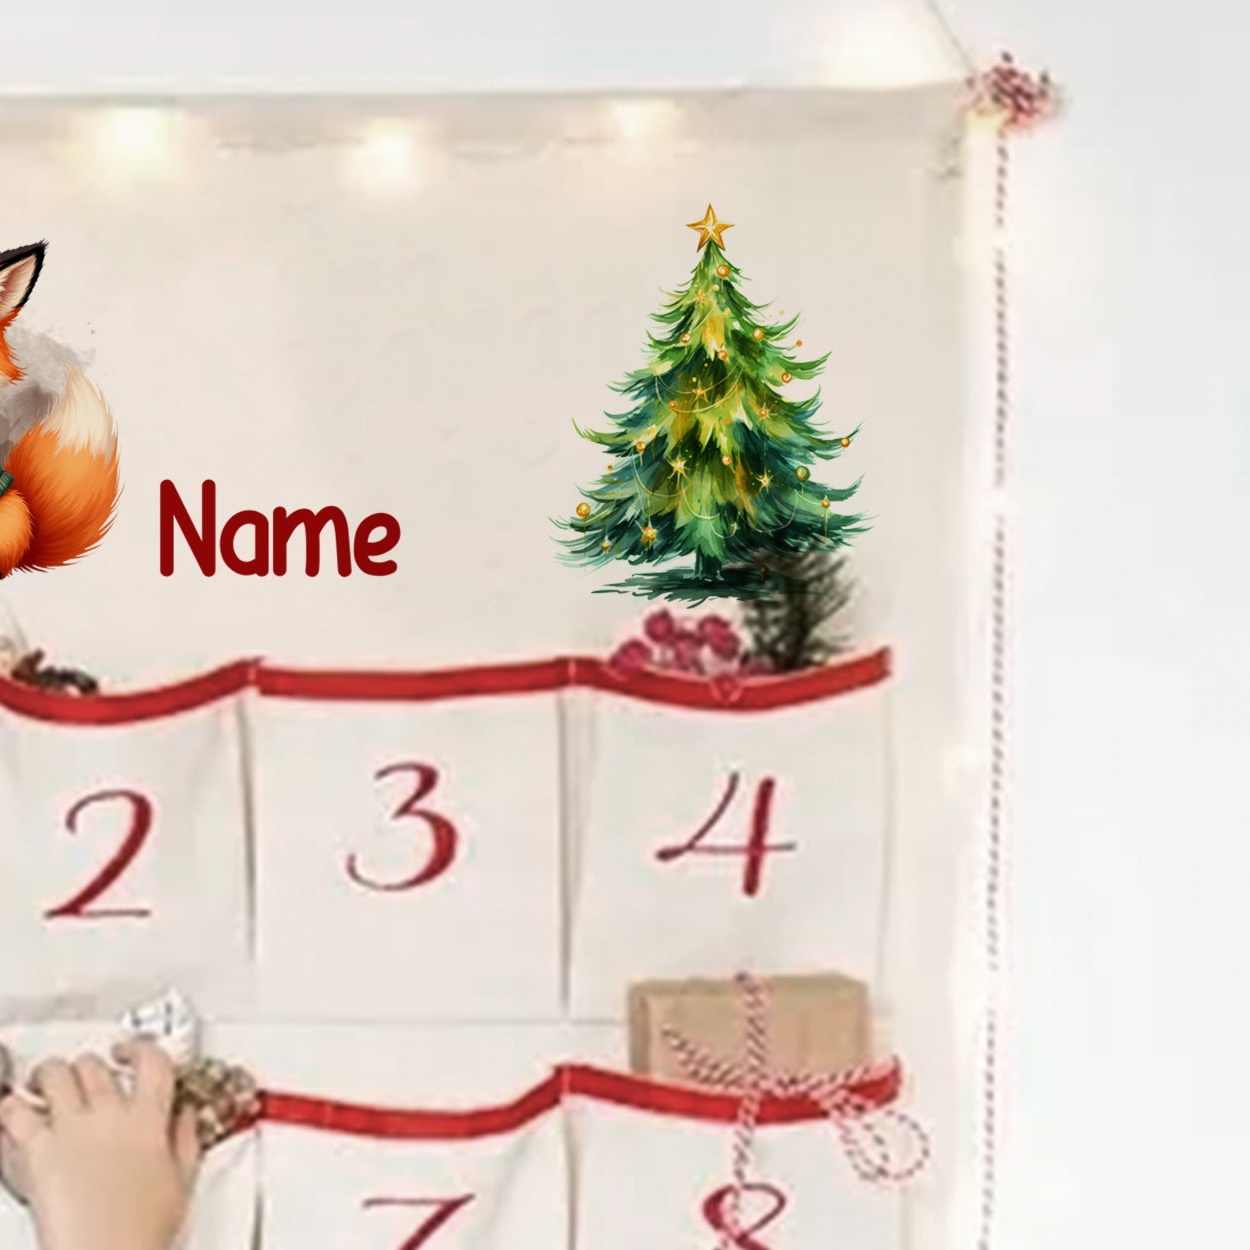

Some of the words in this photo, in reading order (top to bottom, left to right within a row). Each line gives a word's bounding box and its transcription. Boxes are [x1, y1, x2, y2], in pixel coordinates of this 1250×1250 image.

[158, 478, 403, 579] Name
[42, 787, 154, 920] 2
[345, 761, 460, 891] 3
[654, 770, 797, 898] 4
